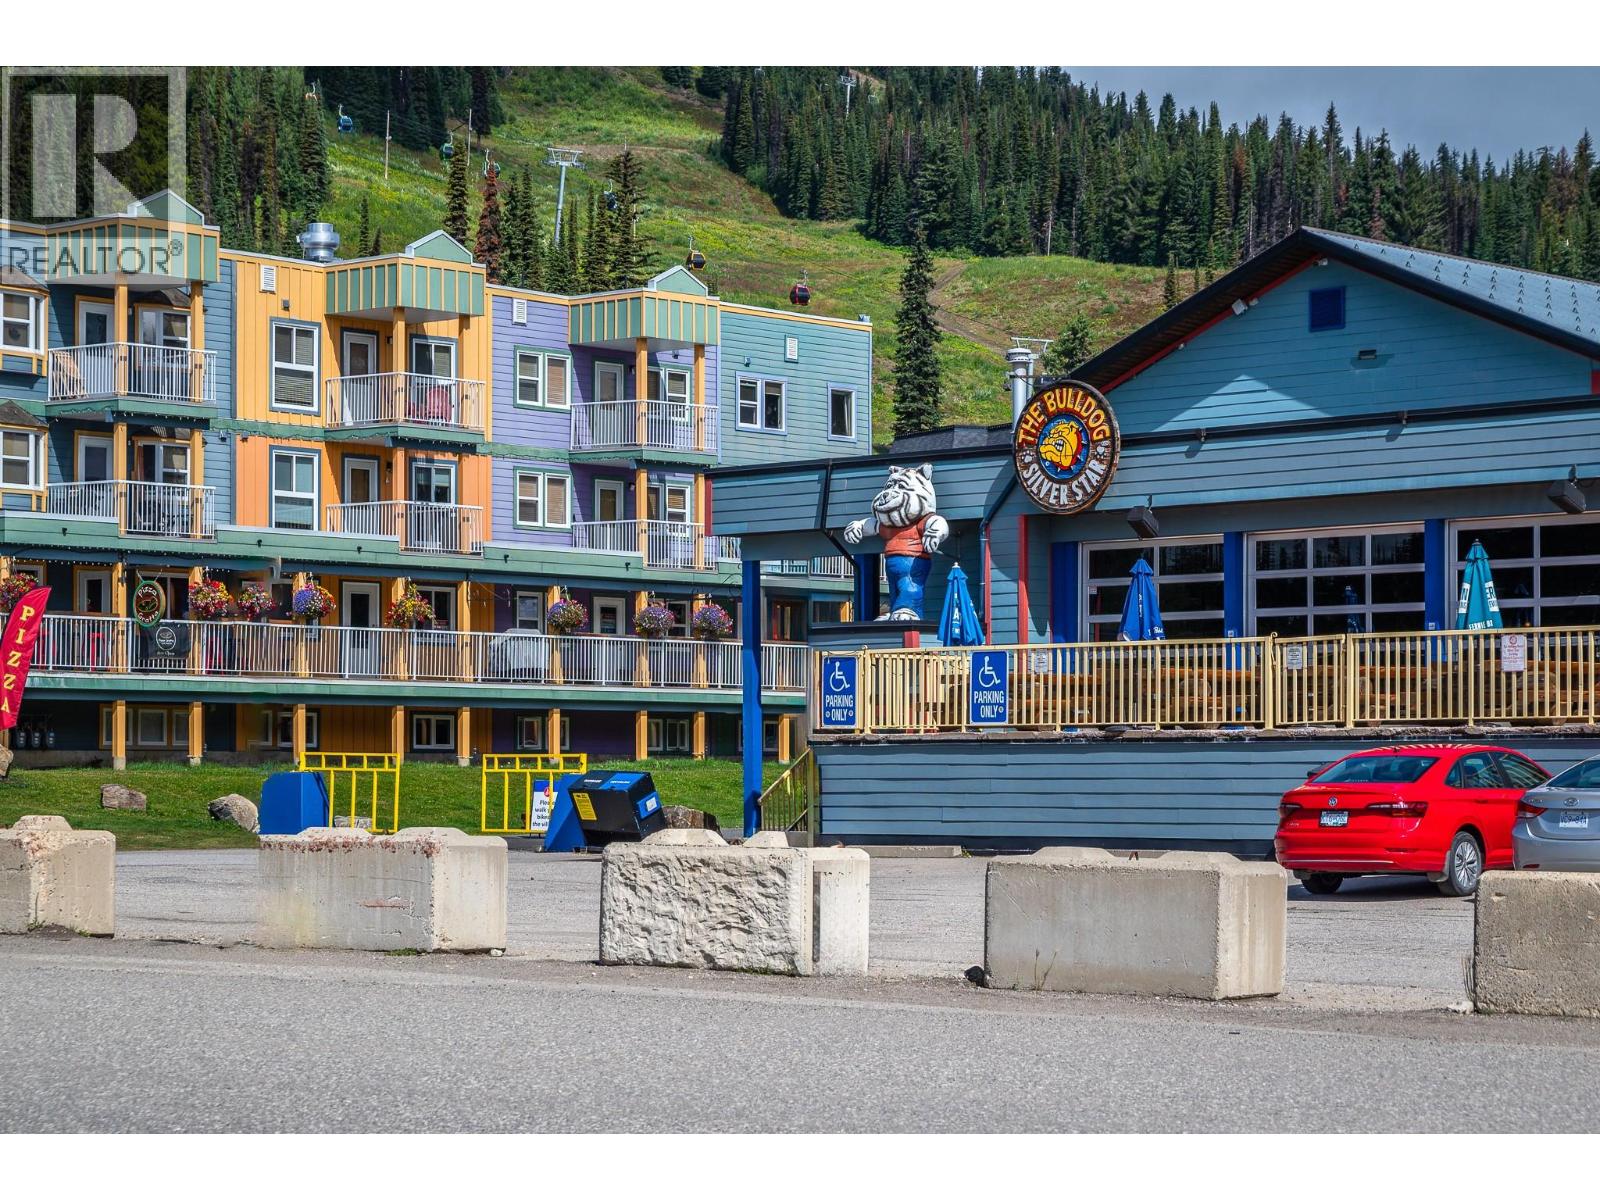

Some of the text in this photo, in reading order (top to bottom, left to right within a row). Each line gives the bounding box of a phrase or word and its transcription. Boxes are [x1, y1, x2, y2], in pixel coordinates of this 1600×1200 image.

[1018, 388, 1111, 443] THE BULLDOG
[1023, 460, 1107, 505] SILVER STAR
[1, 605, 36, 713] PIZZA
[825, 695, 854, 708] PARKING
[973, 691, 1005, 704] PARKING
[831, 708, 848, 721] ONLY
[980, 705, 999, 718] ONLY
